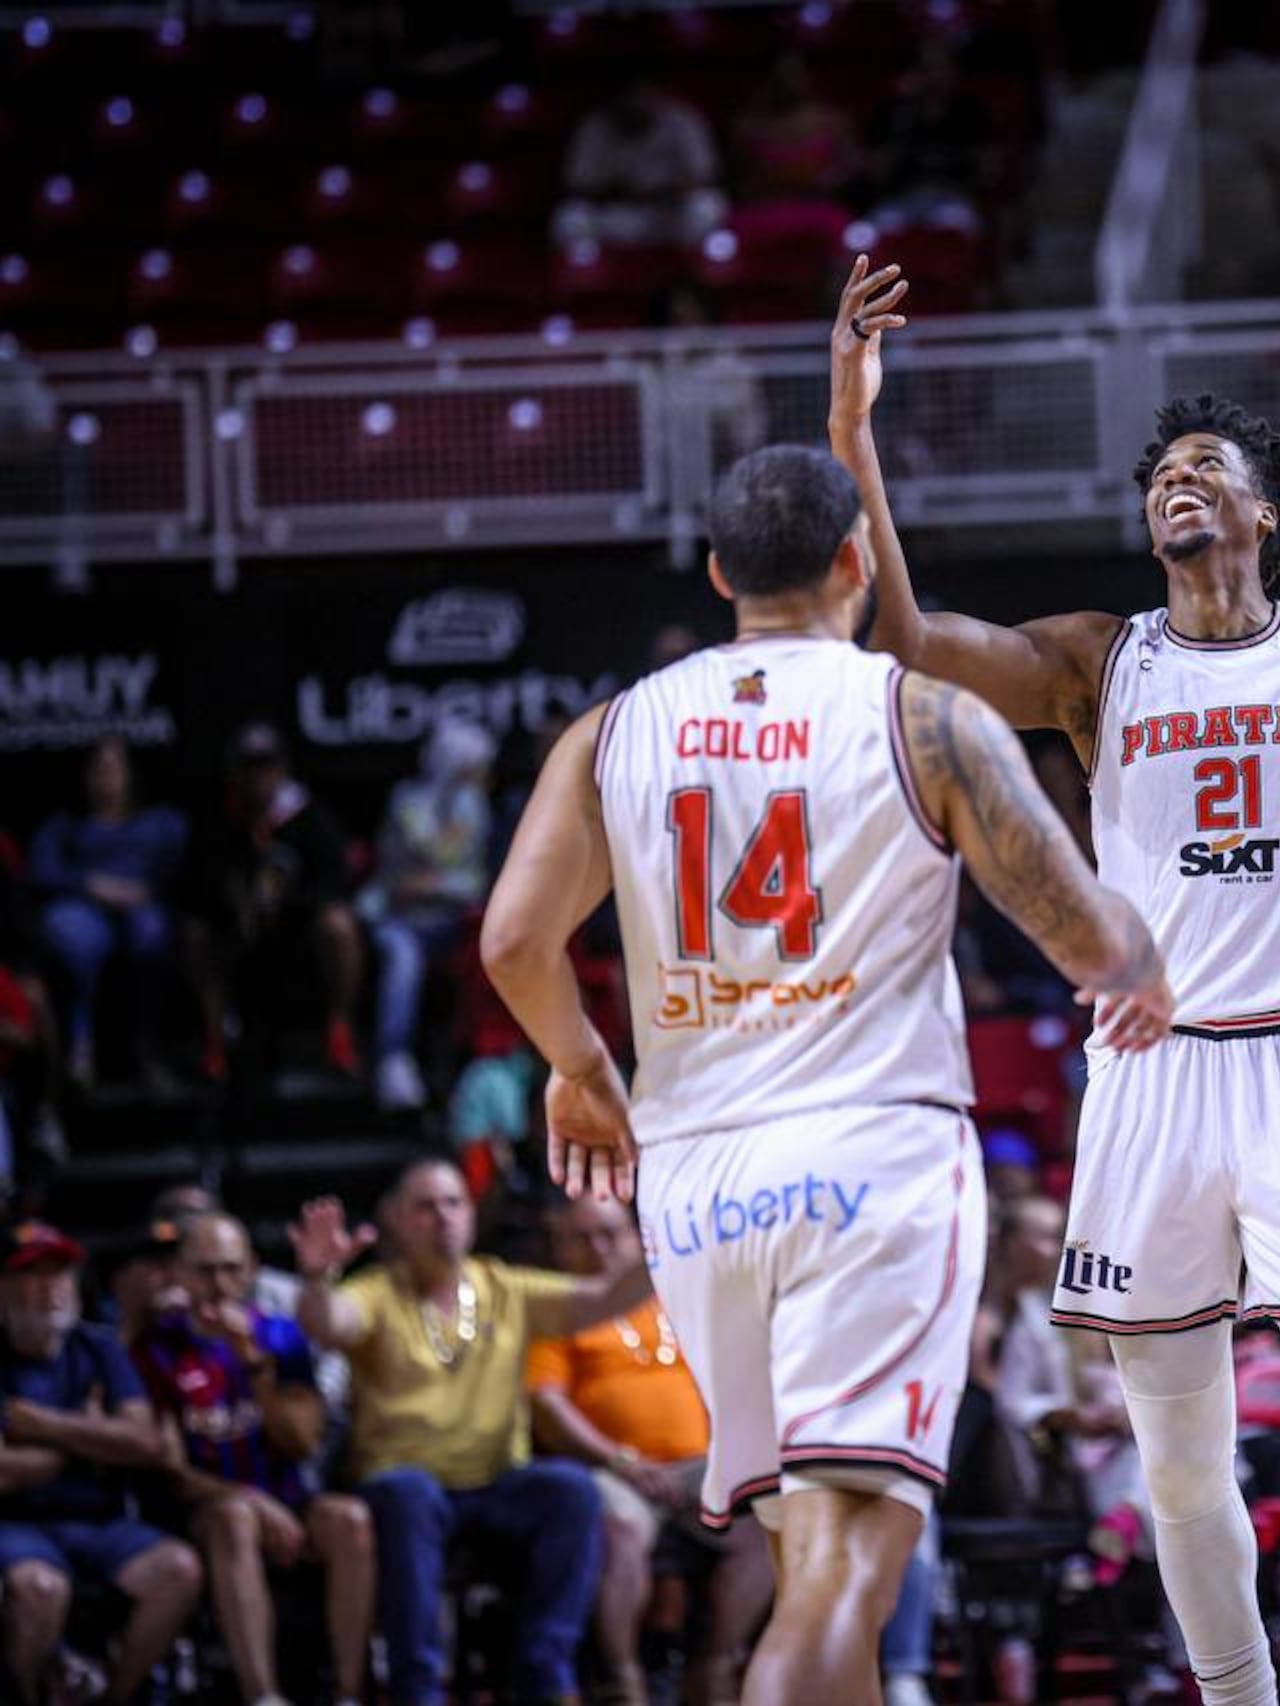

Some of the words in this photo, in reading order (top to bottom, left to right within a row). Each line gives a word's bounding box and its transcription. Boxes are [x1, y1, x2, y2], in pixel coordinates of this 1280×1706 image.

[677, 719, 810, 762] COLON
[1194, 755, 1262, 832] 21
[666, 786, 824, 962] 14
[1220, 875, 1243, 884] rent
[1246, 875, 1253, 883] a
[1256, 874, 1273, 883] car
[664, 1172, 869, 1257] Liberty
[1059, 1247, 1132, 1294] Lite
